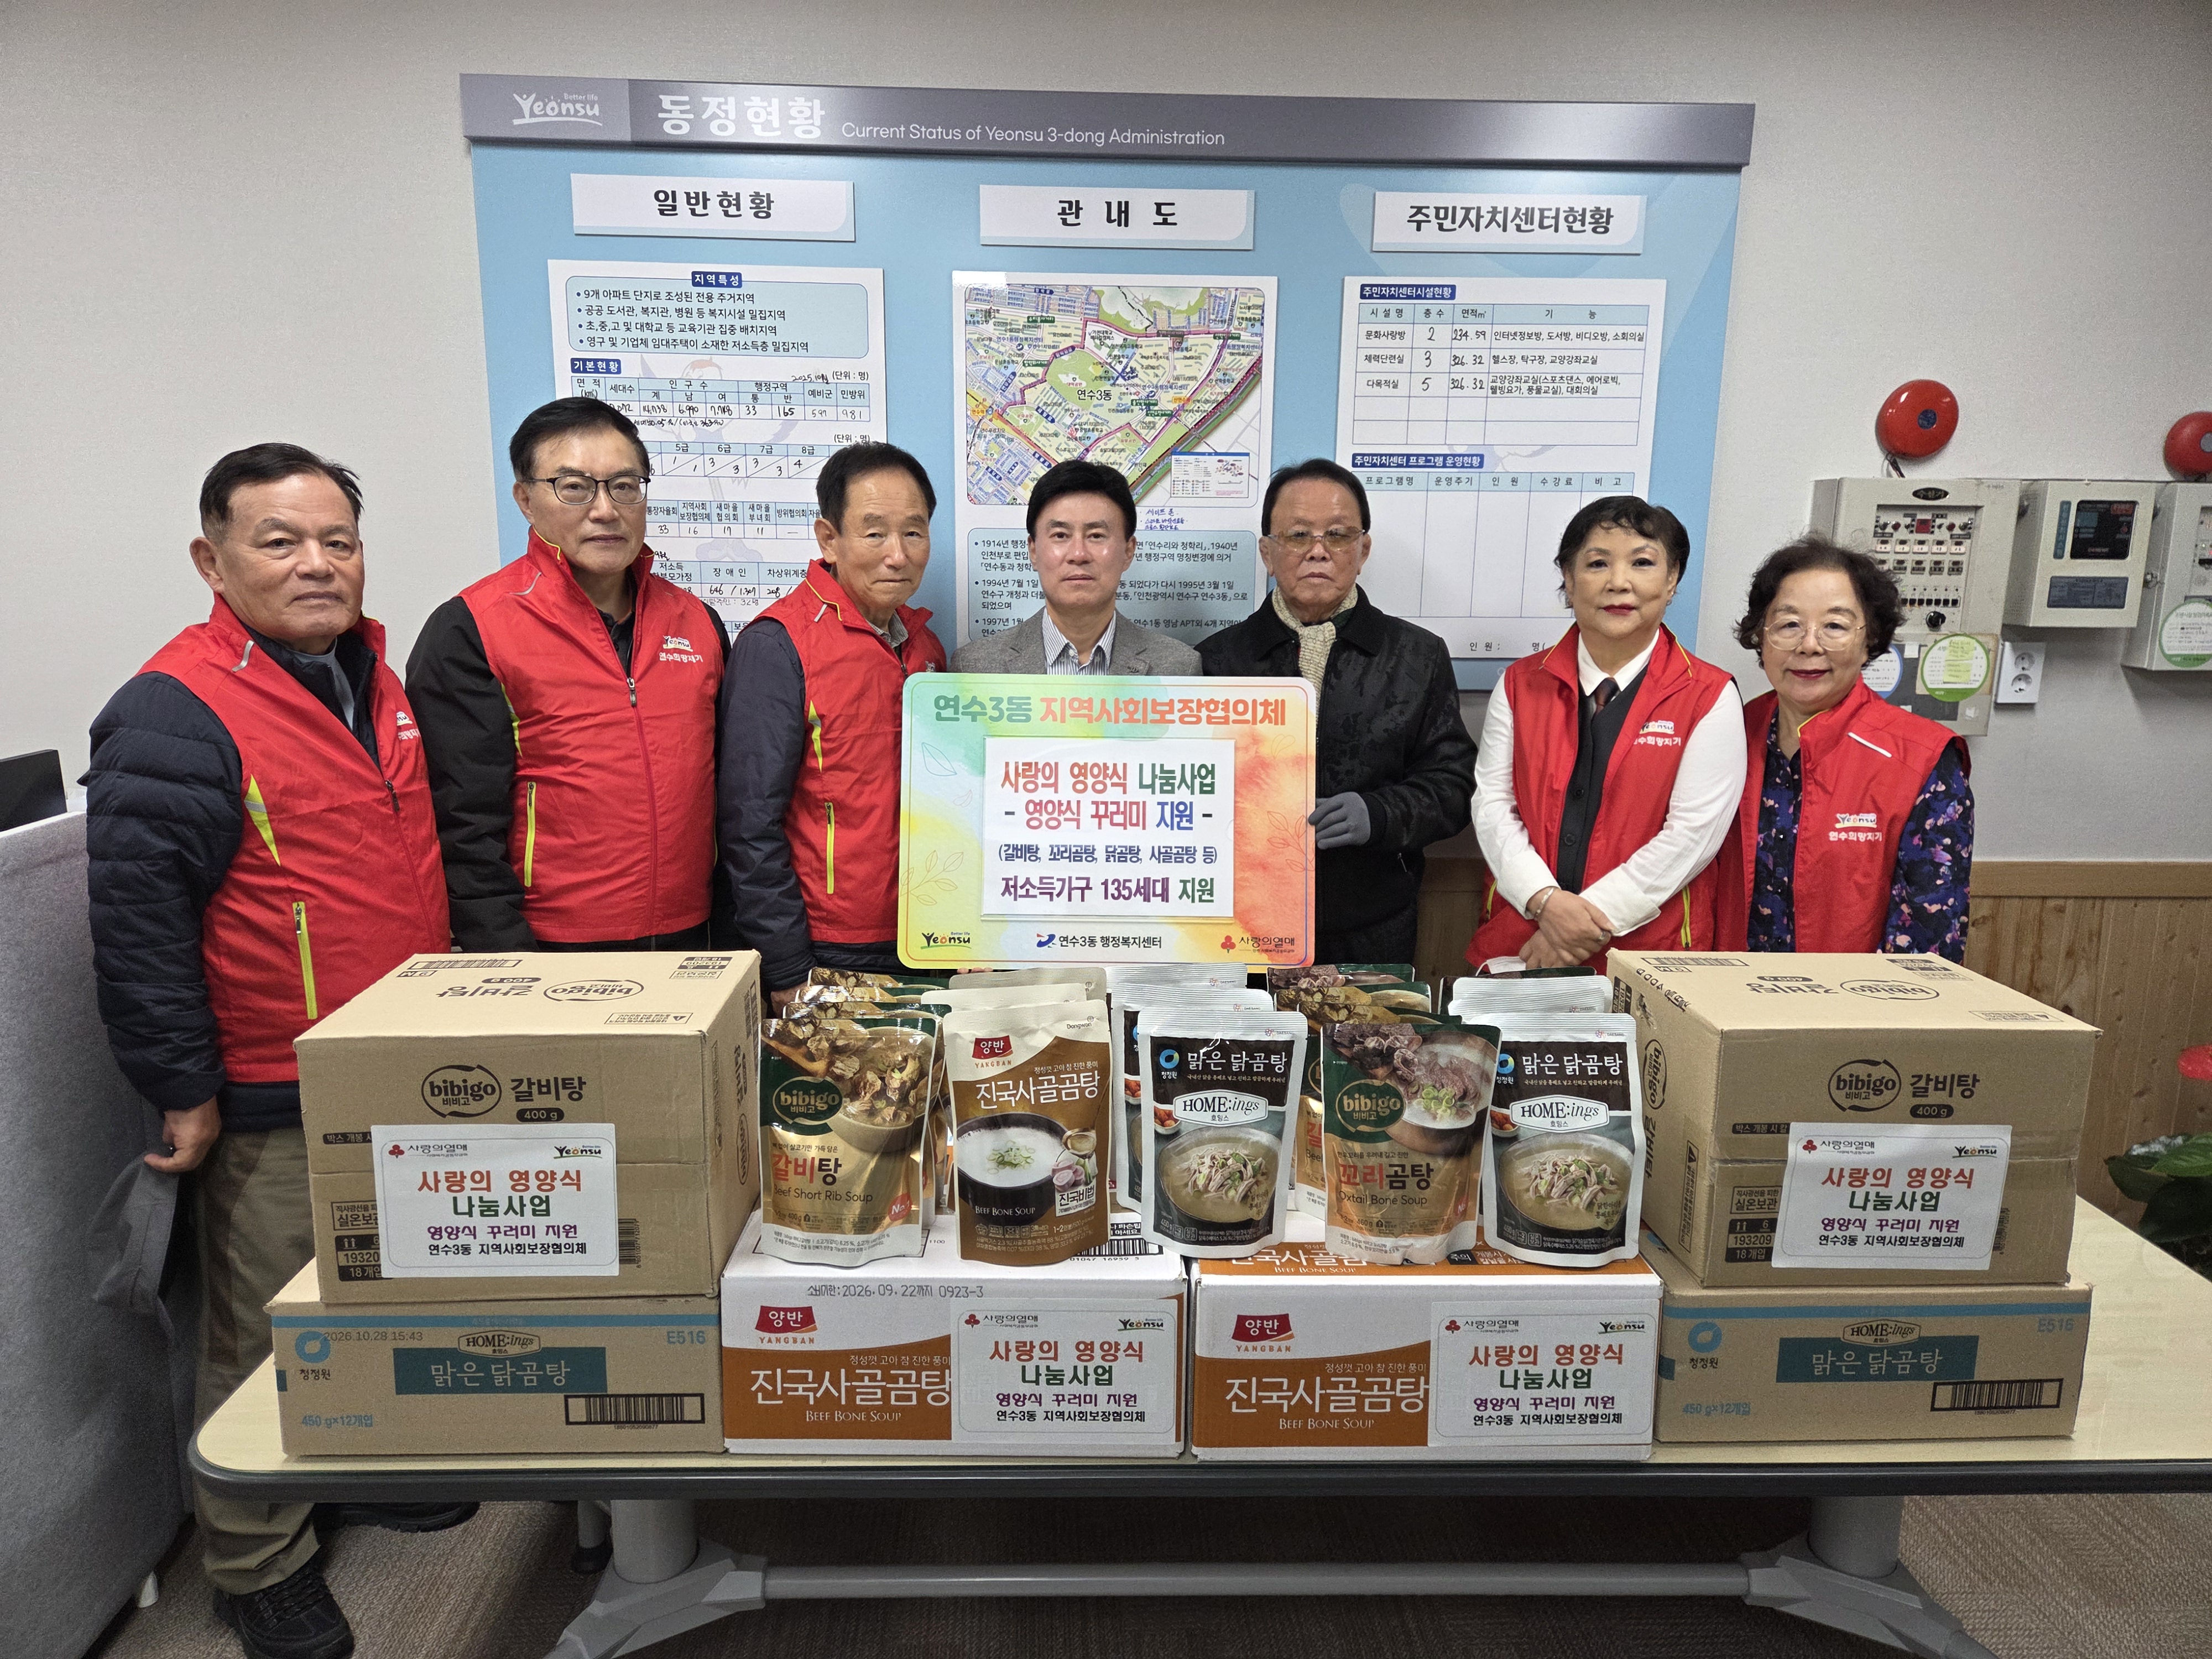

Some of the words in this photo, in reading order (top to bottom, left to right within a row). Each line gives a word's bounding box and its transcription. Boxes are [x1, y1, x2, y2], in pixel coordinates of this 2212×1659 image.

[513, 92, 600, 120] Yeonsu
[659, 95, 825, 138] 동정현황
[842, 122, 905, 138] Current
[910, 123, 961, 139] Status
[966, 125, 982, 140] of
[985, 126, 1043, 142] Yeonsu
[1047, 127, 1105, 145] 3-dong
[1109, 128, 1225, 145] Administration
[654, 189, 774, 220] 일반현황
[1407, 206, 1614, 234] 주민자치센터현황
[695, 274, 739, 285] 지역특성
[584, 290, 599, 300] 9개
[603, 290, 630, 301] 아파트
[634, 291, 662, 301] 단지로
[665, 291, 692, 302] 조성된
[696, 292, 713, 303] 전용
[717, 293, 754, 304] 주거지역
[1363, 286, 1452, 298] 주민자치센터시설현황
[585, 305, 603, 316] 공공
[607, 306, 638, 317] 도서관,
[640, 306, 672, 318] 복지관,
[675, 307, 693, 319] 병원
[696, 307, 705, 319] 등
[708, 309, 745, 320] 복지시설
[749, 309, 785, 321] 밀집지역
[624, 322, 632, 332] 및
[635, 322, 663, 333] 대학교
[666, 323, 675, 334] 등
[678, 324, 716, 335] 교육기관
[718, 324, 736, 335] 집중
[739, 325, 776, 336] 배치지역
[1365, 330, 1406, 340] 문화사랑방
[1494, 331, 1543, 342] 인터넷정보방,
[1547, 332, 1573, 342] 도서방,
[1576, 332, 1610, 342] 비디오방,
[1613, 331, 1644, 342] 소회의실
[587, 337, 606, 348] 영구
[609, 337, 617, 348] 및
[620, 338, 649, 349] 기업체
[652, 338, 698, 350] 임대주택이
[701, 340, 729, 351] 소재한
[732, 340, 769, 352] 저소득층
[772, 341, 808, 353] 밀집지역
[574, 361, 618, 372] 기본현황
[1364, 354, 1404, 364] 체력단련실
[1521, 355, 1546, 366] 탁구장,
[1550, 355, 1597, 366] 교양강좌교실
[609, 384, 635, 394] 세대수
[755, 382, 787, 392] 행정구역
[808, 390, 832, 399] 예비군
[841, 390, 865, 400] 민방위
[1366, 379, 1399, 389] 다목적실
[1077, 389, 1112, 401] 연수3동
[778, 406, 795, 417] 165
[760, 446, 773, 454] 7급
[802, 446, 815, 455] 8급
[1354, 456, 1406, 466] 주민자치센터
[1408, 456, 1443, 467] 프로그램
[1446, 456, 1480, 467] 운영현황
[680, 512, 710, 521] 보장협의체
[682, 503, 706, 512] 지역사회
[777, 509, 806, 518] 방위협의회
[1129, 581, 1159, 589] 되었다가
[1006, 591, 1029, 599] 개청과
[982, 602, 1011, 610] 되었으며
[934, 695, 1032, 722] 연수3동
[1040, 696, 1286, 727] 지역사회보장협의체
[1001, 762, 1058, 794] 사랑의
[1070, 763, 1128, 795] 영양식
[1139, 763, 1215, 796] 나눔사업
[1025, 800, 1081, 829] 영양식
[1091, 800, 1146, 830] 꾸러미
[1156, 801, 1193, 830] 지원
[999, 844, 1041, 863] (갈비탕,
[1049, 845, 1096, 863] 꼬리곰탕,
[1105, 846, 1142, 864] 닭곰탕,
[1150, 846, 1197, 864] 사골곰탕
[1202, 846, 1217, 864] 등)
[1001, 877, 1092, 902] 저소득가구
[1100, 877, 1169, 902] 135세대
[1179, 878, 1214, 902] 지원
[921, 932, 971, 946] Yeonsu
[1058, 935, 1097, 949] 연수3동
[1100, 935, 1162, 949] 행정복지센터
[1240, 936, 1295, 948] 사랑의열매
[980, 1040, 1004, 1053] 양반
[975, 1060, 1011, 1068] YANGBAN
[1188, 1051, 1226, 1071] 맑은
[1231, 1051, 1287, 1073] 닭곰탕
[1522, 1053, 1559, 1074] 맑은
[1564, 1053, 1623, 1075] 닭곰탕
[429, 1079, 496, 1103] bibigo
[510, 1076, 586, 1101] 갈비탕
[976, 1071, 1100, 1109] 진국사골곰탕
[1835, 1074, 1896, 1097] bibigo
[1910, 1073, 1980, 1098] 갈비탕
[442, 1097, 471, 1106] 비비고
[780, 1091, 839, 1111] bibigo
[1183, 1097, 1259, 1115] HOME:ings
[1343, 1094, 1400, 1115] bibigo
[1521, 1103, 1599, 1121] HOME:ings
[408, 1144, 467, 1153] 사랑의열매
[554, 1145, 601, 1157] Yeonsu
[773, 1154, 842, 1186] 갈비탕
[1339, 1162, 1434, 1191] 꼬리곰탕
[418, 1170, 491, 1193] 사랑의
[509, 1170, 581, 1192] 영양식
[1822, 1168, 1892, 1188] 사랑의
[1907, 1168, 1974, 1188] 영양식
[794, 1188, 822, 1200] Short
[825, 1190, 842, 1201] Rib
[846, 1191, 873, 1203] Soup
[1339, 1191, 1367, 1204] Oxtail
[1371, 1194, 1398, 1205] Bone
[1401, 1196, 1427, 1206] Soup
[1849, 1191, 1940, 1212] 나눔사업
[453, 1195, 550, 1217] 나눔사업
[1735, 1199, 1777, 1211] 실온보관
[1734, 1235, 1772, 1245] 193209
[429, 1244, 472, 1255] 연수3동
[479, 1243, 586, 1255] 지역사회보장협의체
[769, 1311, 803, 1327] 양반
[1245, 1319, 1280, 1334] 양반
[391, 1331, 422, 1342] 15:43
[466, 1335, 534, 1349] HOME:ings
[667, 1330, 706, 1344] E516
[299, 1369, 331, 1381] 청정원
[431, 1361, 484, 1387] 맑은
[491, 1360, 570, 1387] 닭곰탕
[750, 1368, 951, 1406] 진국사골곰탕
[1225, 1376, 1430, 1415] 진국사골곰탕
[806, 1411, 831, 1422] BEEF
[834, 1411, 867, 1422] BONE
[870, 1411, 901, 1422] SOUP
